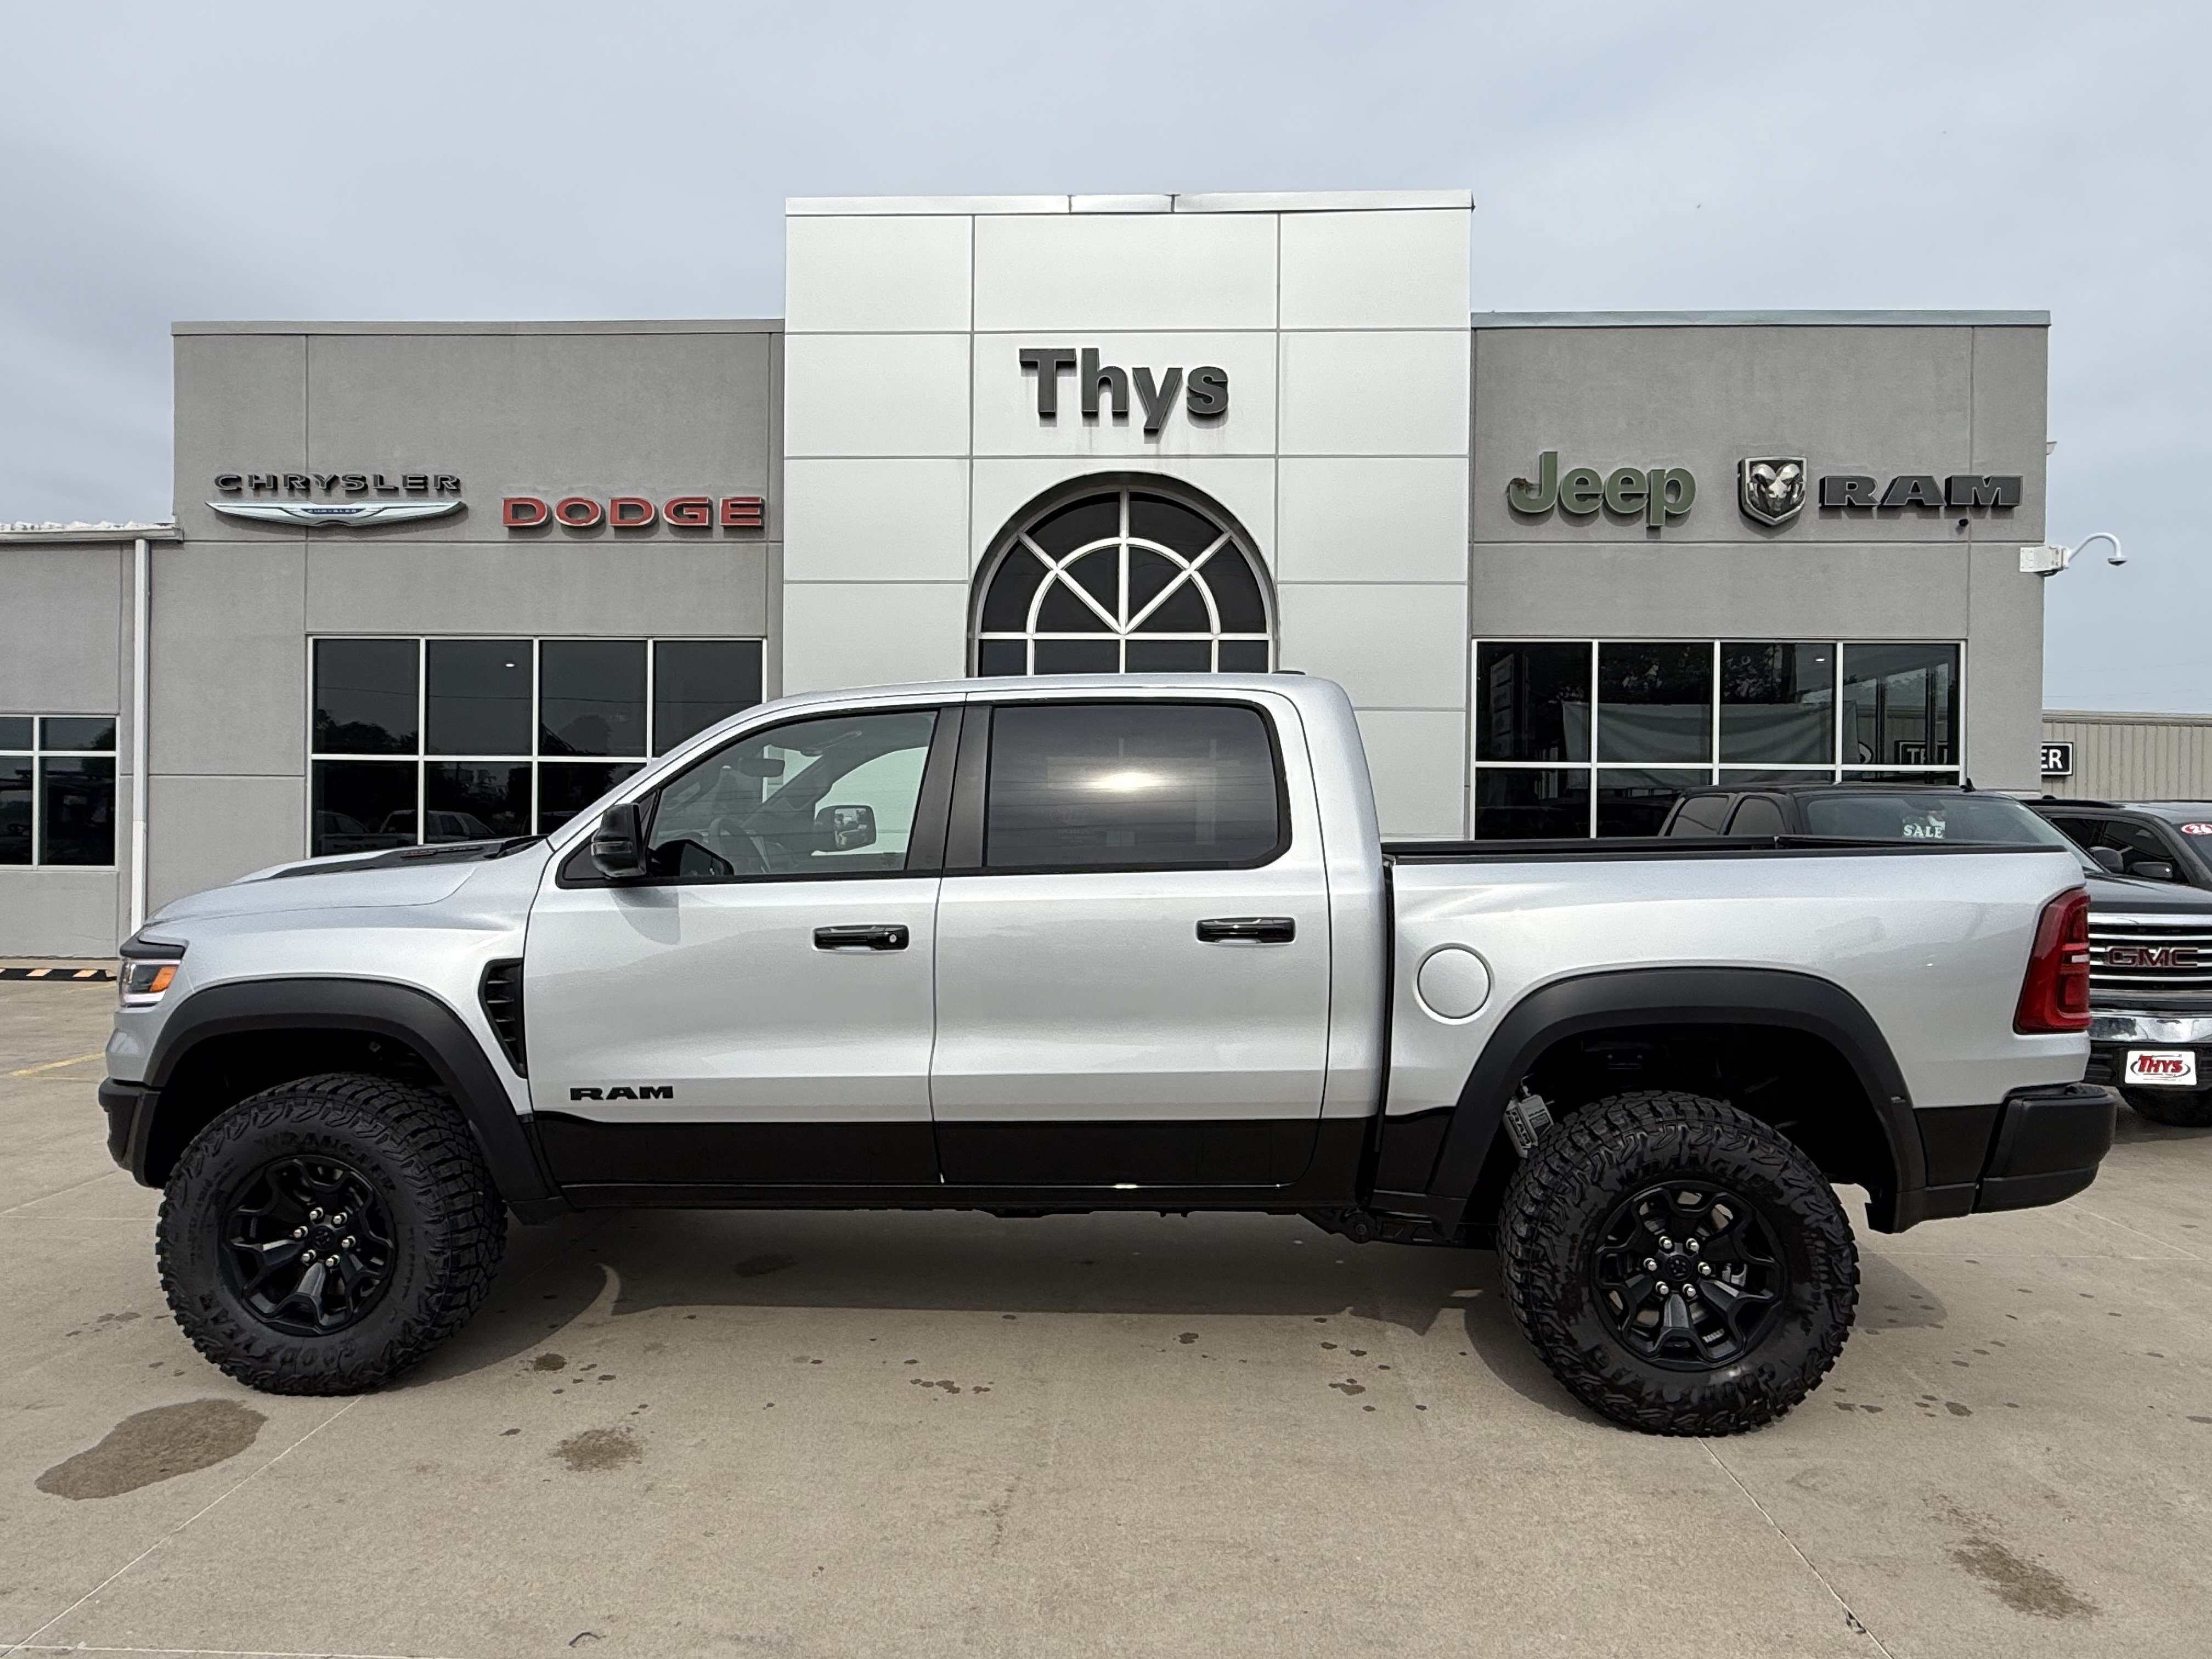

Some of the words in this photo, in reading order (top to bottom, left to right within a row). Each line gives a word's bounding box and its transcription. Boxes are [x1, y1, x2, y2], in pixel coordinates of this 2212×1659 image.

[1019, 348, 1229, 433] Thys
[215, 473, 461, 492] CHRYSLER
[1508, 450, 1696, 527] Jeep
[1819, 475, 2023, 509] RAM
[502, 496, 764, 529] DODGE
[1903, 824, 1944, 839] SALE
[2107, 946, 2199, 968] GMC
[570, 1086, 674, 1101] RAM
